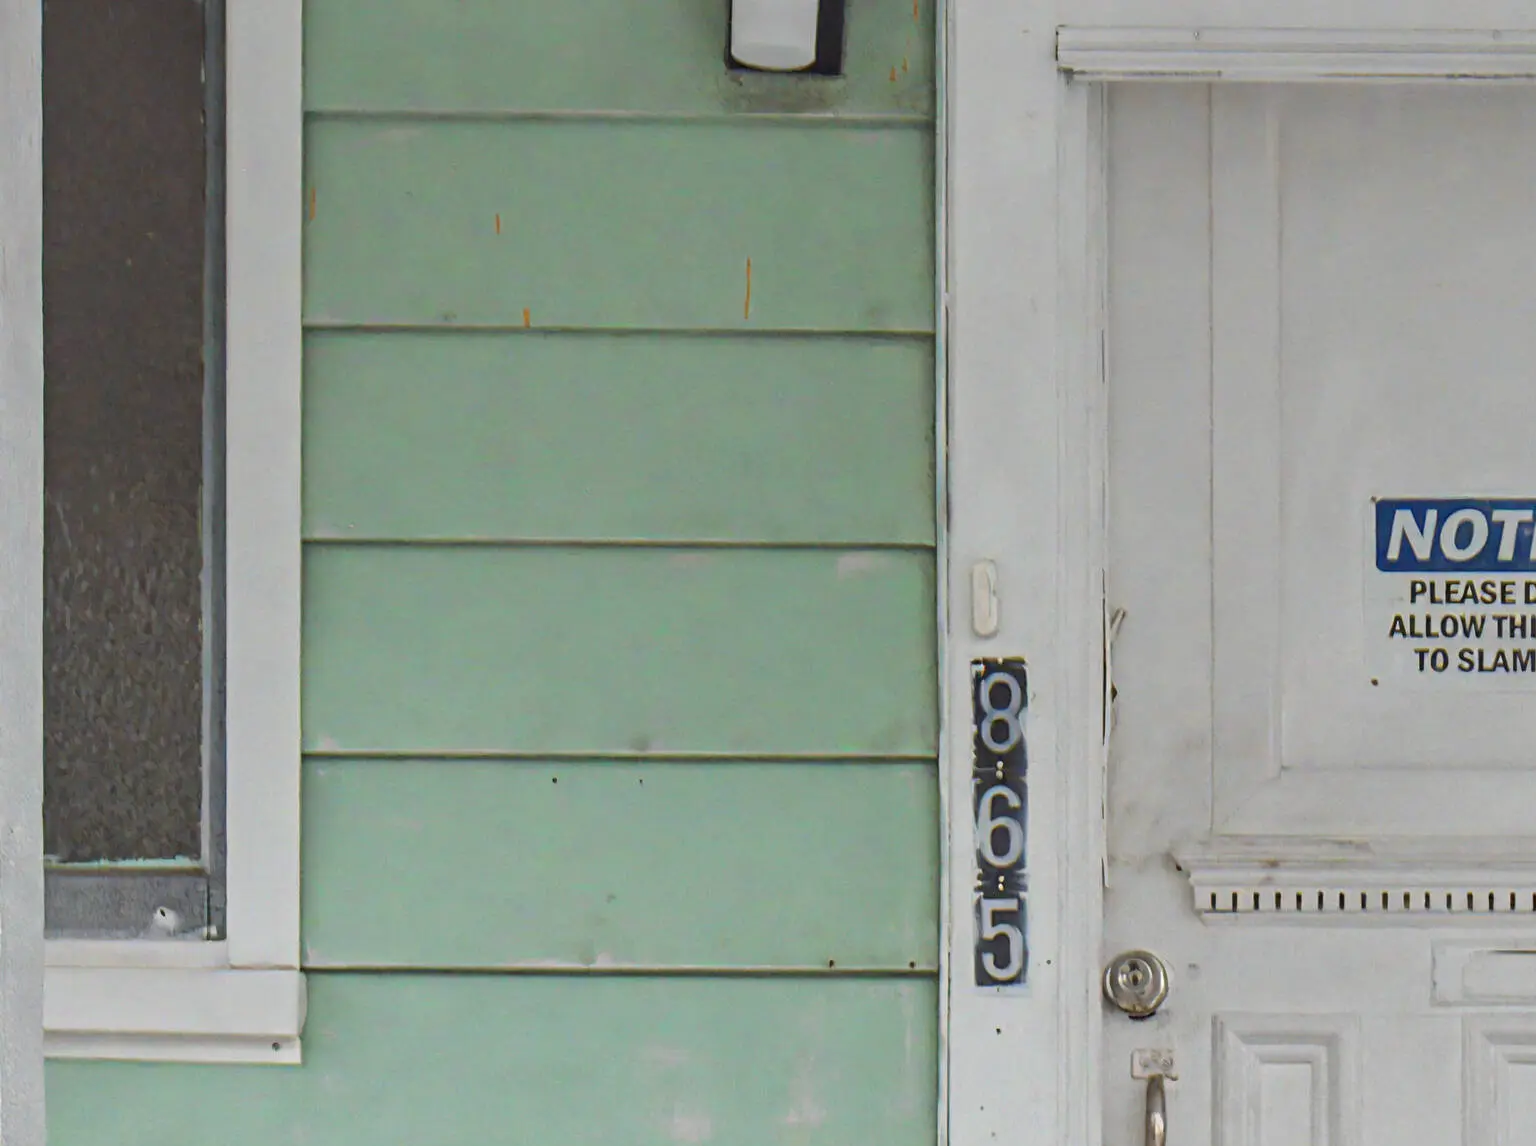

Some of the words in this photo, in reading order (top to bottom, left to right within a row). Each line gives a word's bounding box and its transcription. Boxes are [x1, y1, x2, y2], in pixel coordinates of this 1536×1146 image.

[1409, 580, 1516, 605] PLEASE
[1389, 613, 1486, 639] ALLOW
[1414, 648, 1449, 673] TO
[1457, 648, 1536, 673] SLAM
[978, 671, 1023, 981] 865
